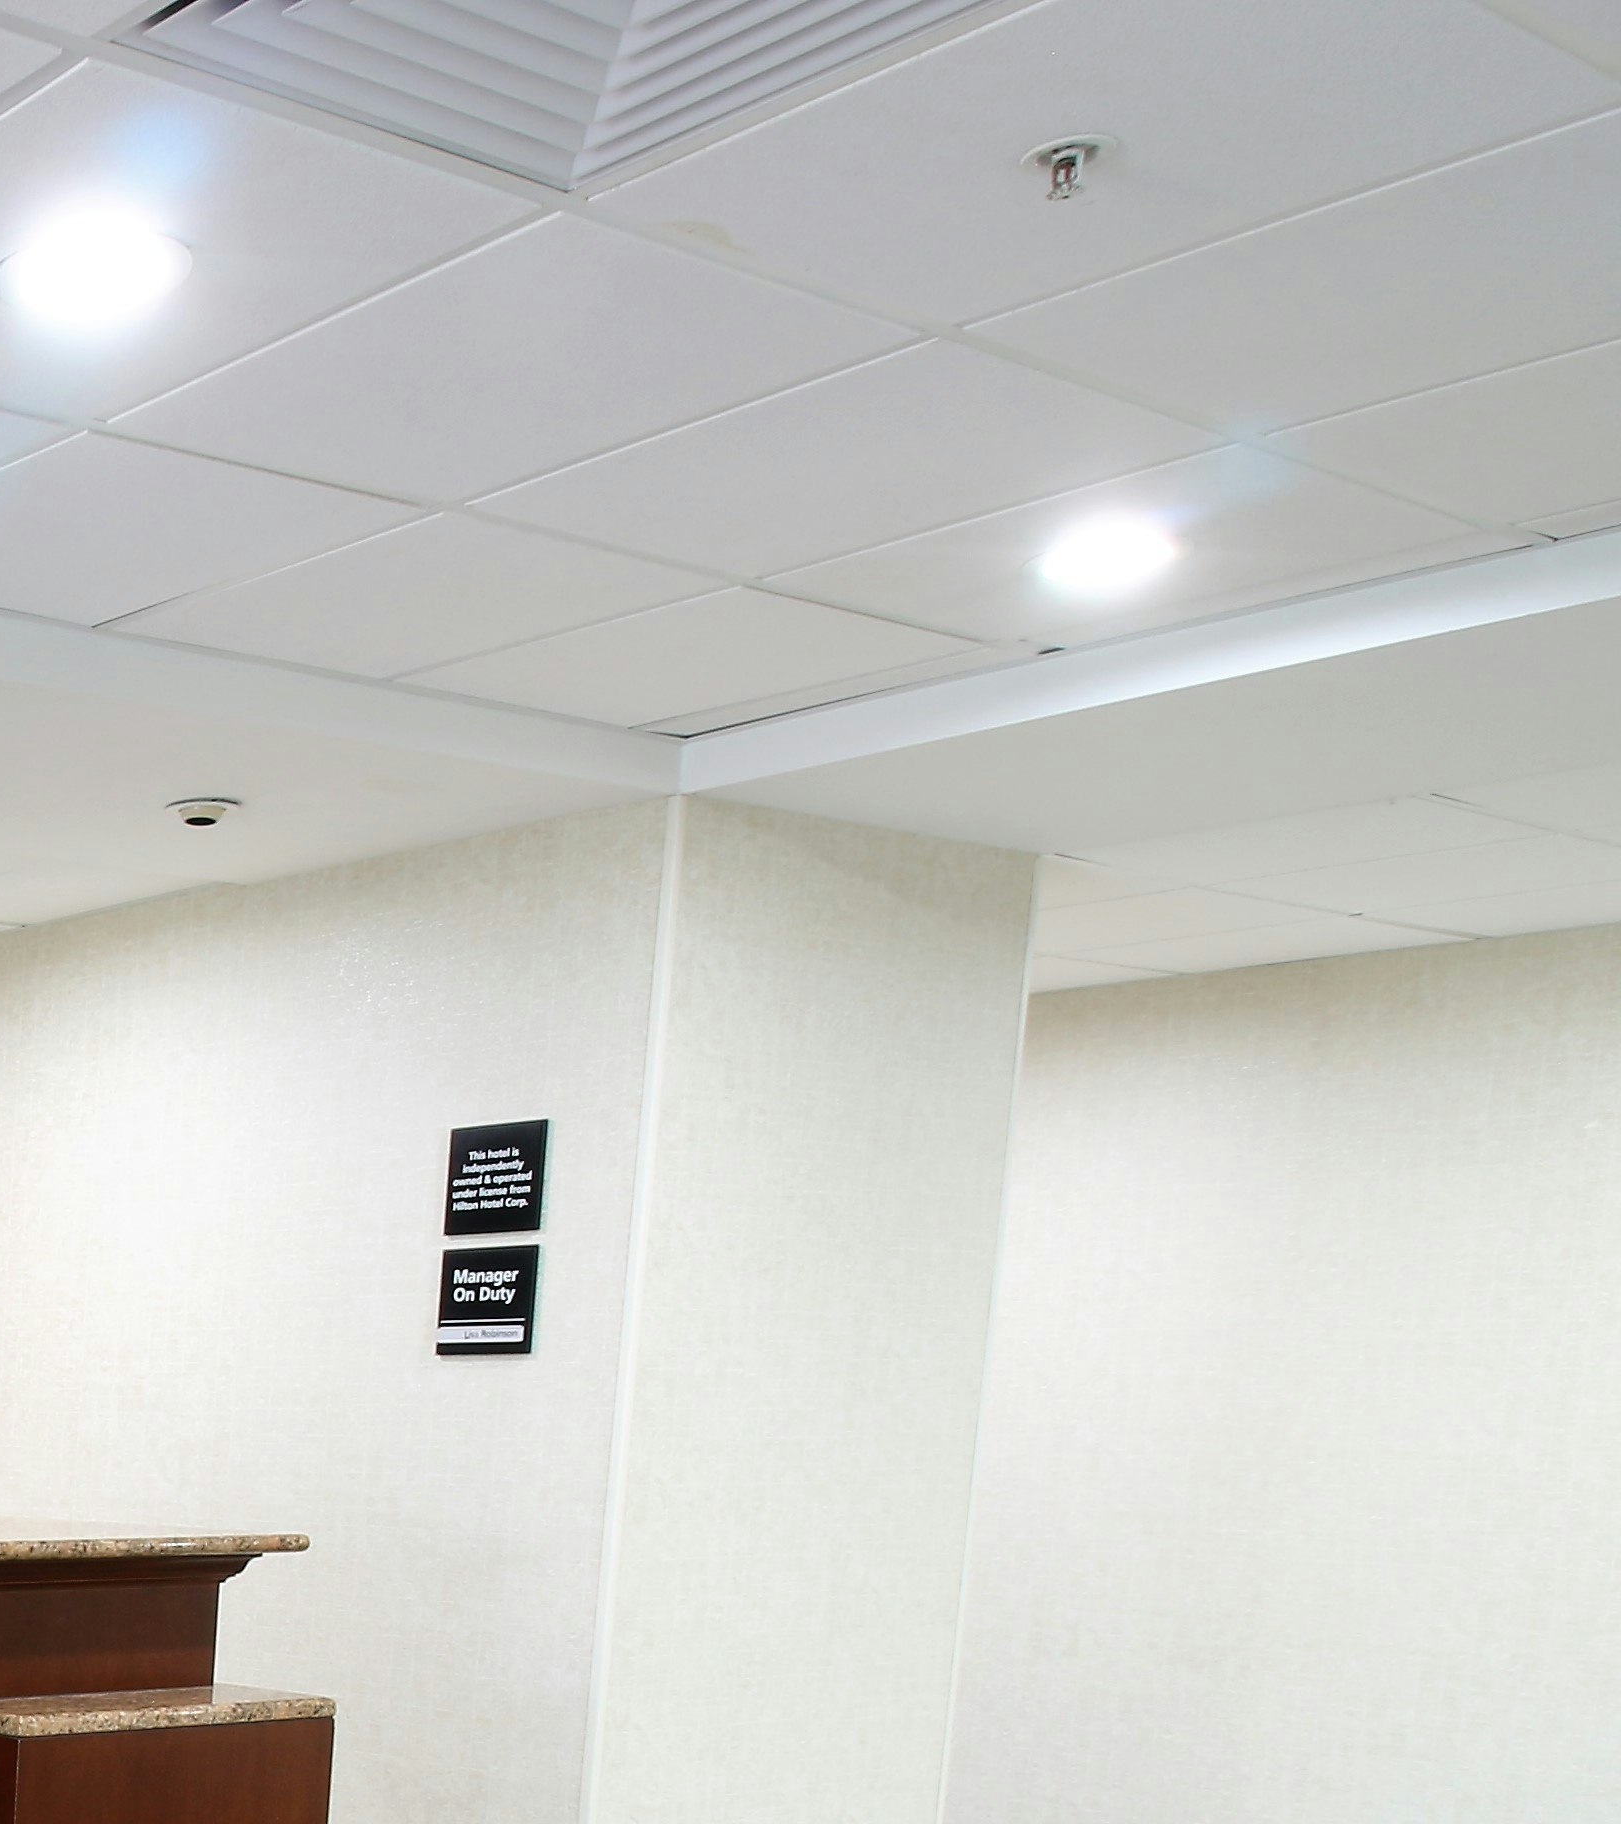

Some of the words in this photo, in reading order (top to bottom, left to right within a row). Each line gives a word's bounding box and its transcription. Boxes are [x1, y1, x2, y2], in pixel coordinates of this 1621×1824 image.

[468, 1150, 486, 1160] This
[487, 1147, 510, 1159] hotel
[511, 1146, 519, 1157] is
[462, 1159, 525, 1174] independently
[452, 1175, 482, 1186] owned
[493, 1169, 533, 1185] operated
[452, 1188, 477, 1199] under
[509, 1184, 531, 1194] from
[452, 1200, 479, 1211] Hilton
[480, 1197, 504, 1209] Hotel
[505, 1197, 529, 1208] Corp.
[453, 1268, 520, 1287] Manager
[453, 1287, 476, 1302] On
[479, 1286, 517, 1305] Duty
